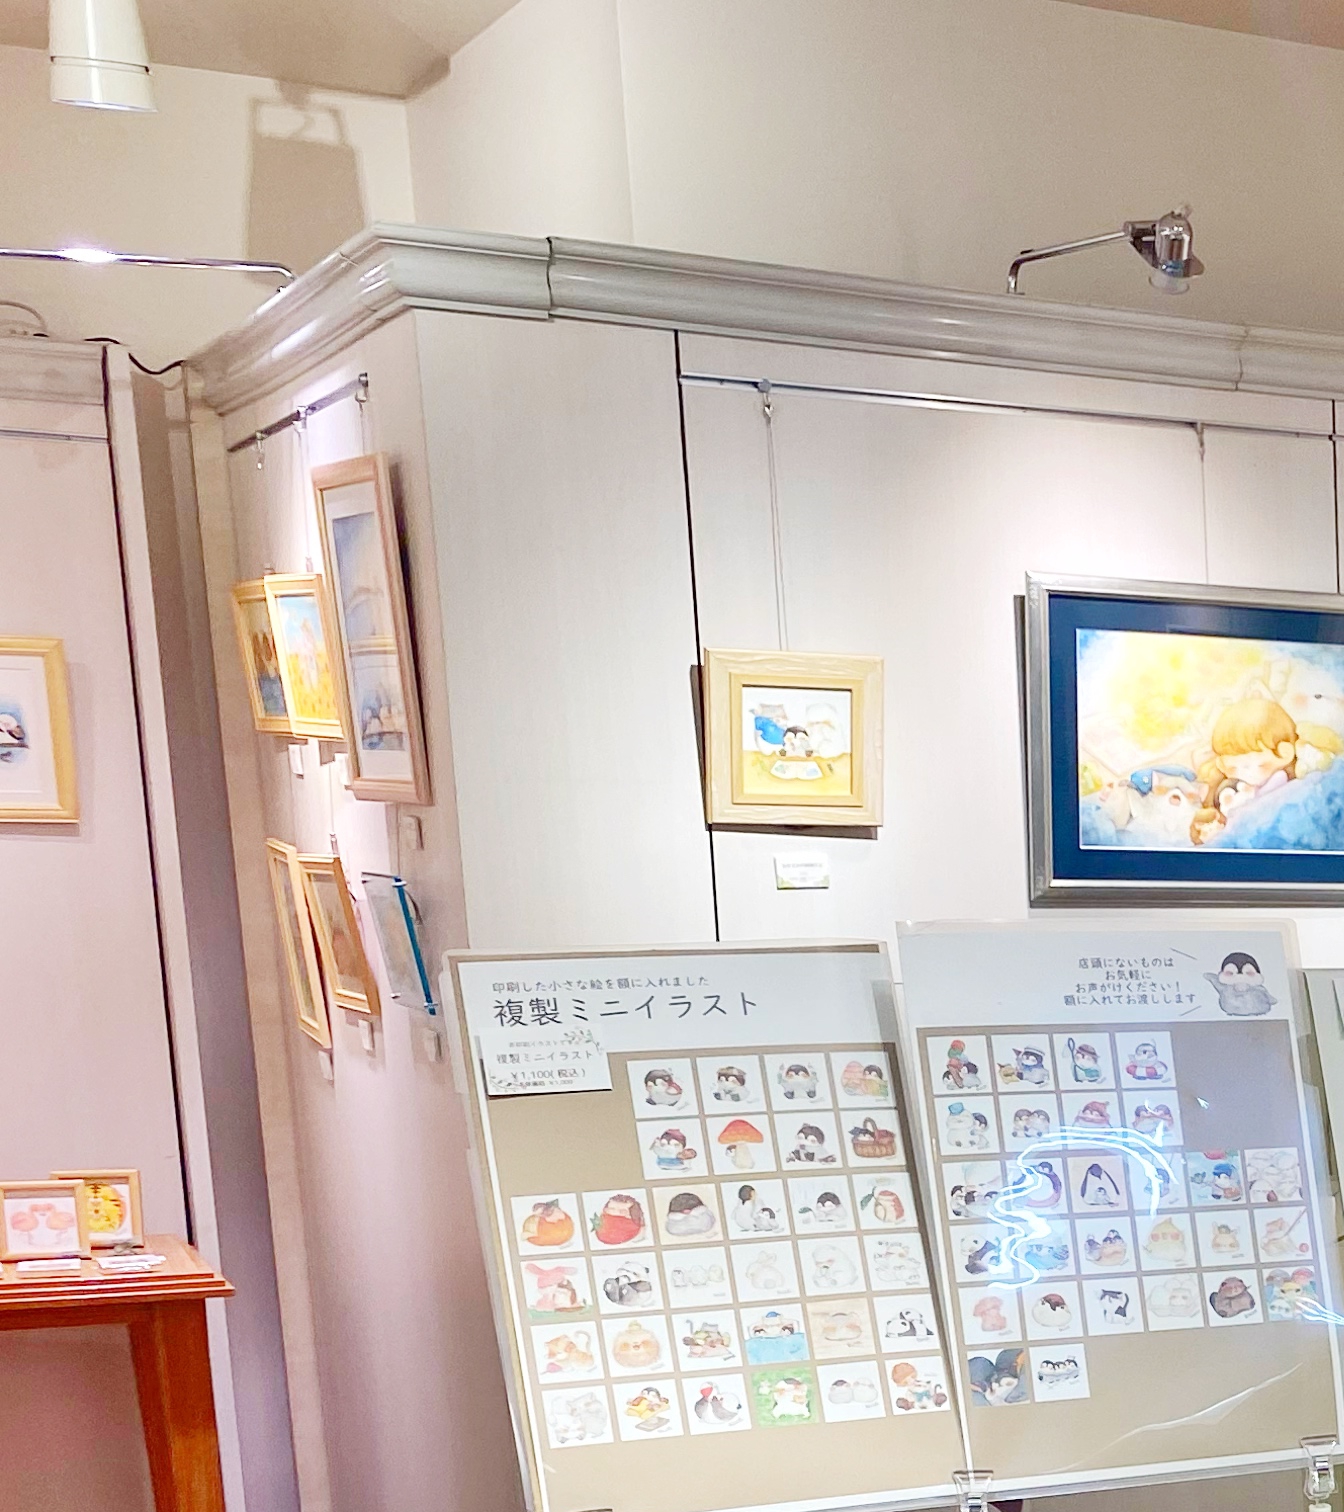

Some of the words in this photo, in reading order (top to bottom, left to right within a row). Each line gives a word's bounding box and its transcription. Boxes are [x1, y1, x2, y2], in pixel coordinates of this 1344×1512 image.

[1078, 957, 1174, 969] 店頭にないものは
[1105, 969, 1152, 981] お気軽に
[492, 975, 709, 993] 印刷した小さな絵を額に入れました
[1063, 993, 1196, 1006] 額に入れてお渡しします
[493, 992, 757, 1028] 複製ミニイラスト
[496, 1050, 593, 1065] 複製ミニイラスト
